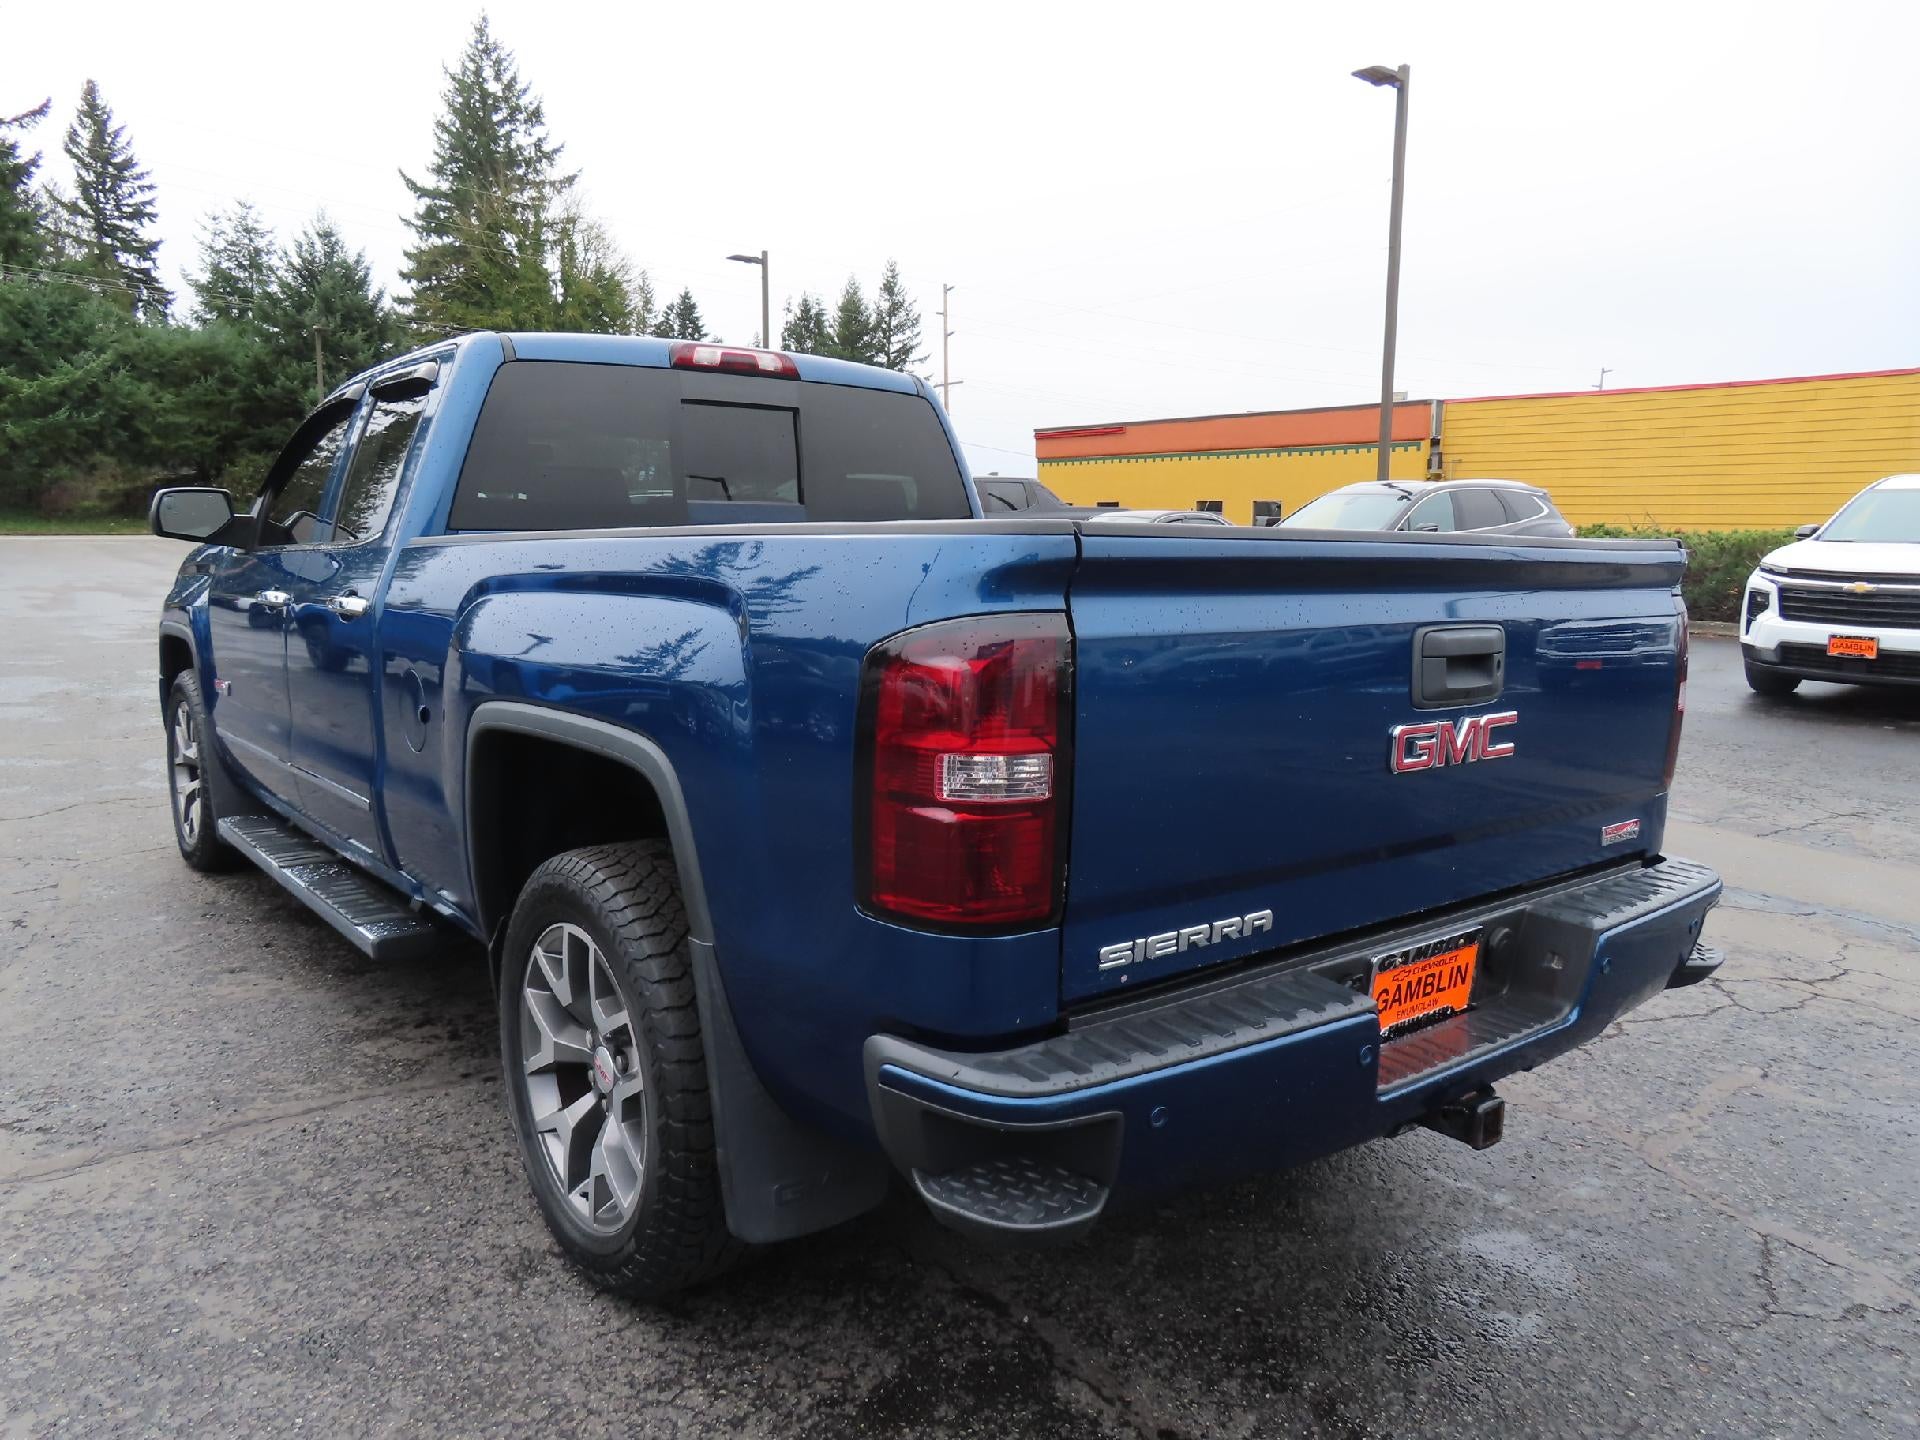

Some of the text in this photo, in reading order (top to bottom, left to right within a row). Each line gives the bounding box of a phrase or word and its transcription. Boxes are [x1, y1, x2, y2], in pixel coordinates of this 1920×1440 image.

[1832, 643, 1874, 652] GAMBLIN
[1389, 711, 1517, 774] GMC
[1098, 909, 1274, 971] SIERRA
[1412, 954, 1459, 976] CHEVROLET
[1376, 962, 1470, 1015] GAMBLIN
